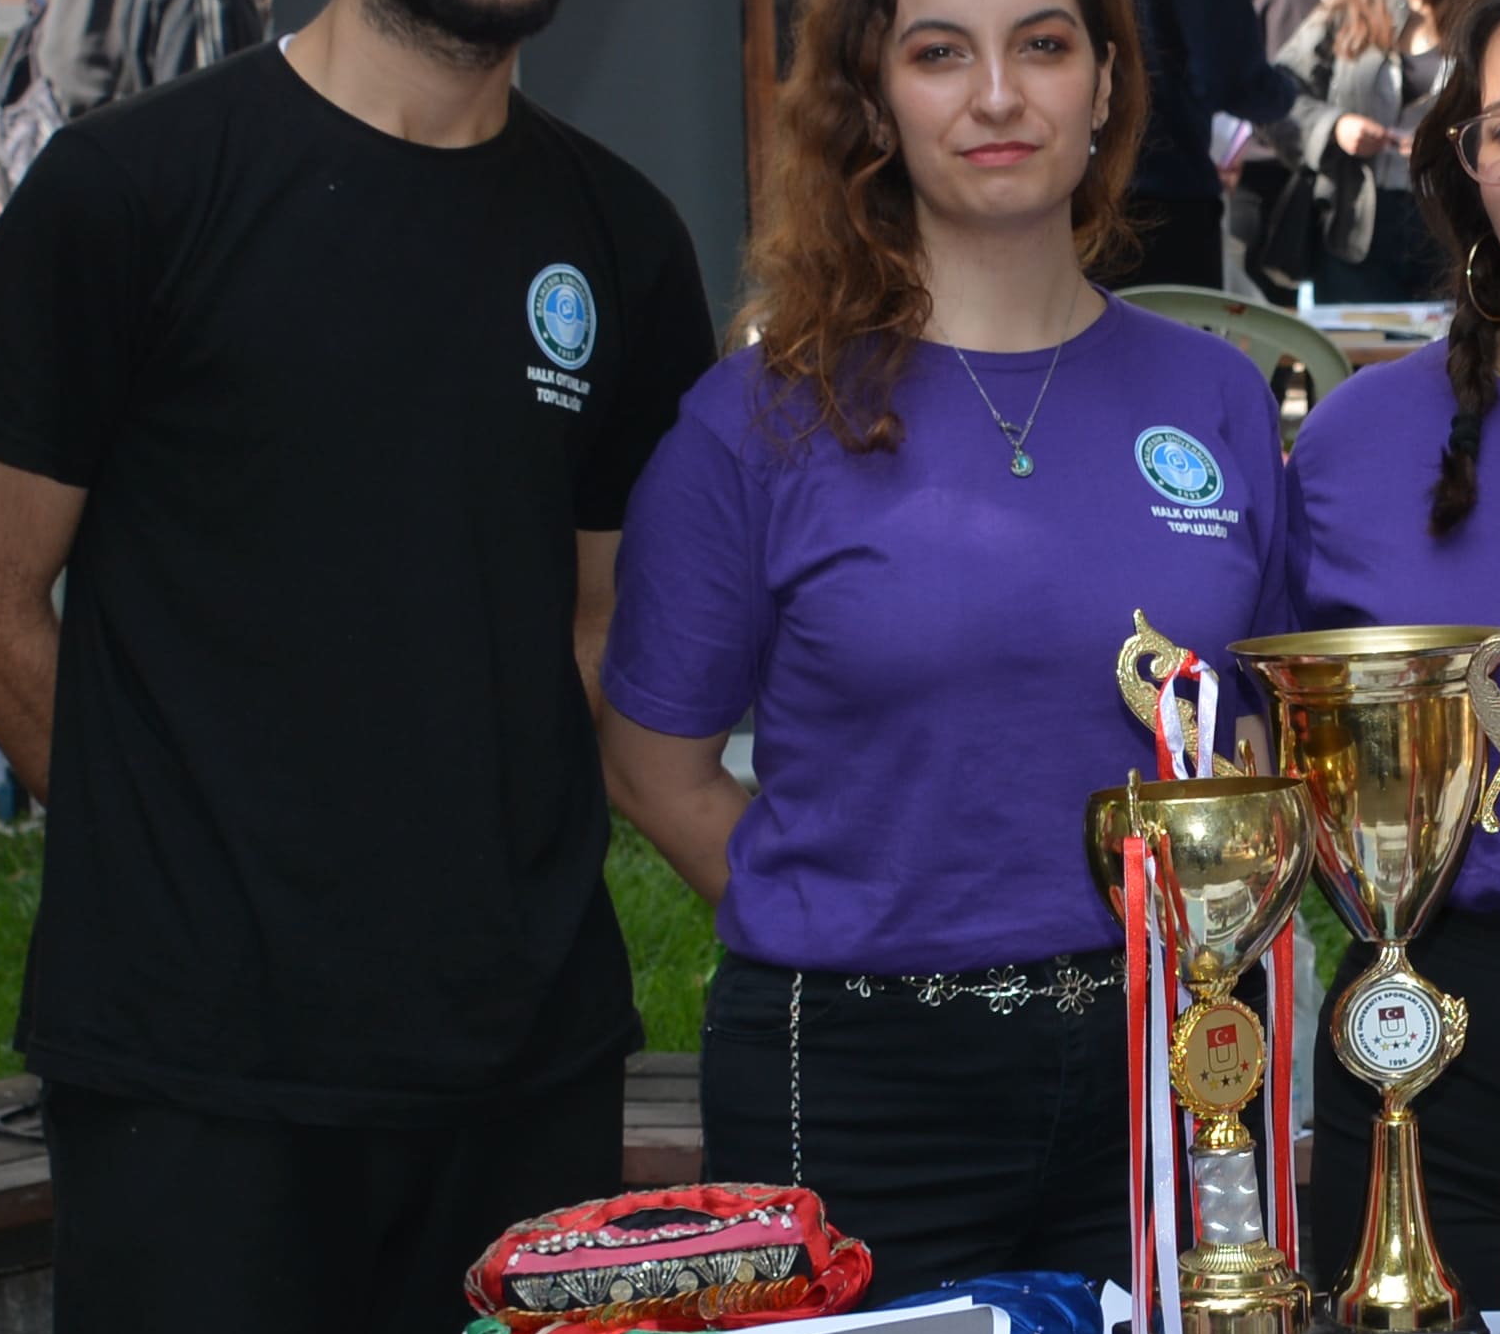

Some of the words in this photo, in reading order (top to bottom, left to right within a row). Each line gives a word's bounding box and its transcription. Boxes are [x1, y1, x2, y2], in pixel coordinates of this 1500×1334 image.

[526, 364, 556, 384] HALK
[1150, 505, 1183, 520] HALK
[1183, 507, 1240, 524] OYUNLARI
[1383, 991, 1419, 1006] SPORLARI
